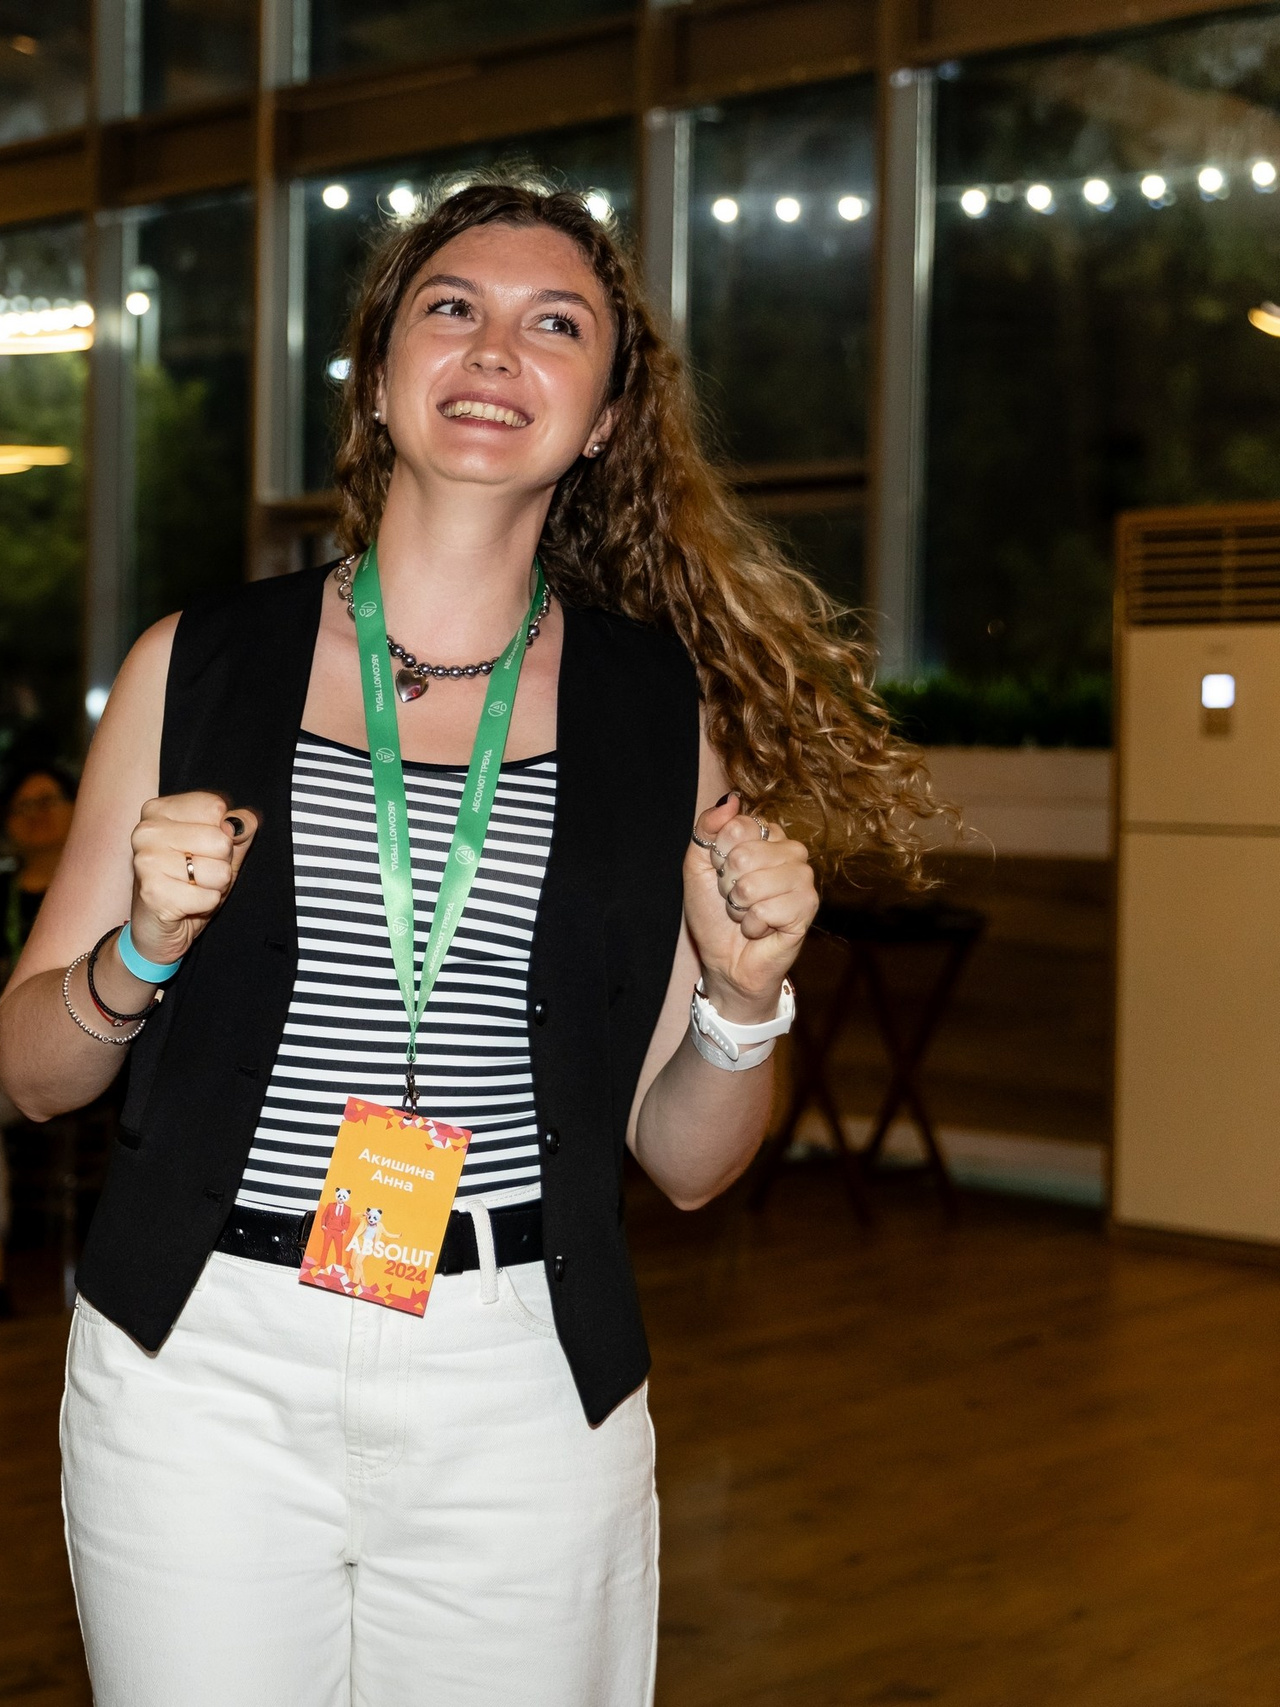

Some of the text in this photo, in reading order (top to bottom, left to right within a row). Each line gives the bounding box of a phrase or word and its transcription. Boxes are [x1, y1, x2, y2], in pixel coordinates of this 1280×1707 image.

[371, 654, 382, 689] АБСОЛЮТ
[471, 774, 486, 813] АБСОЛЮТ
[387, 800, 398, 841] АБСОЛЮТ
[429, 930, 445, 974] АБСОЛЮТ
[358, 1148, 435, 1181] Акишина
[371, 1170, 413, 1192] Анна
[345, 1236, 434, 1268] ABSOLUT
[384, 1260, 427, 1284] 2024
